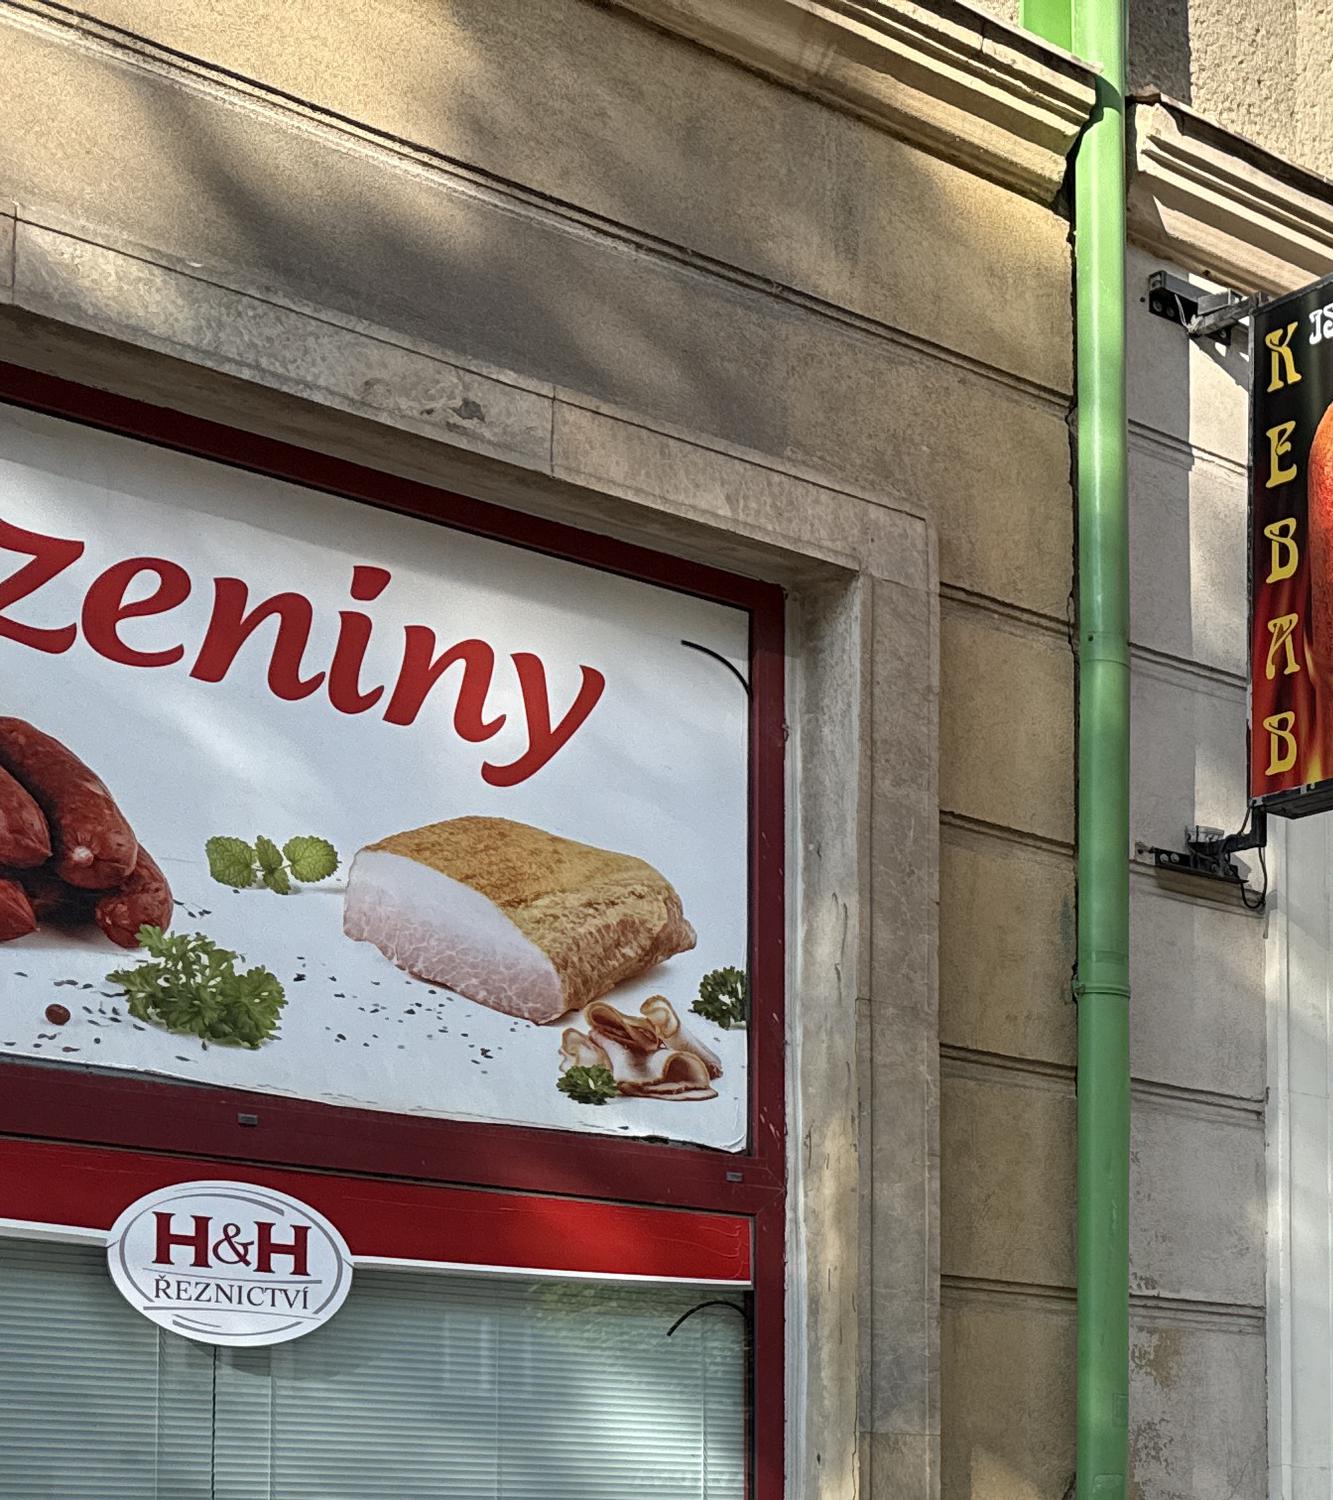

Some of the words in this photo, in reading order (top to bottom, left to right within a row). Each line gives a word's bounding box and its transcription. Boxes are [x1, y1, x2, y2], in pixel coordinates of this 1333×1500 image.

[1264, 322, 1302, 776] KEBAB
[152, 1211, 312, 1276] H&H
[154, 1274, 309, 1310] ŘEZNICTVÍ
